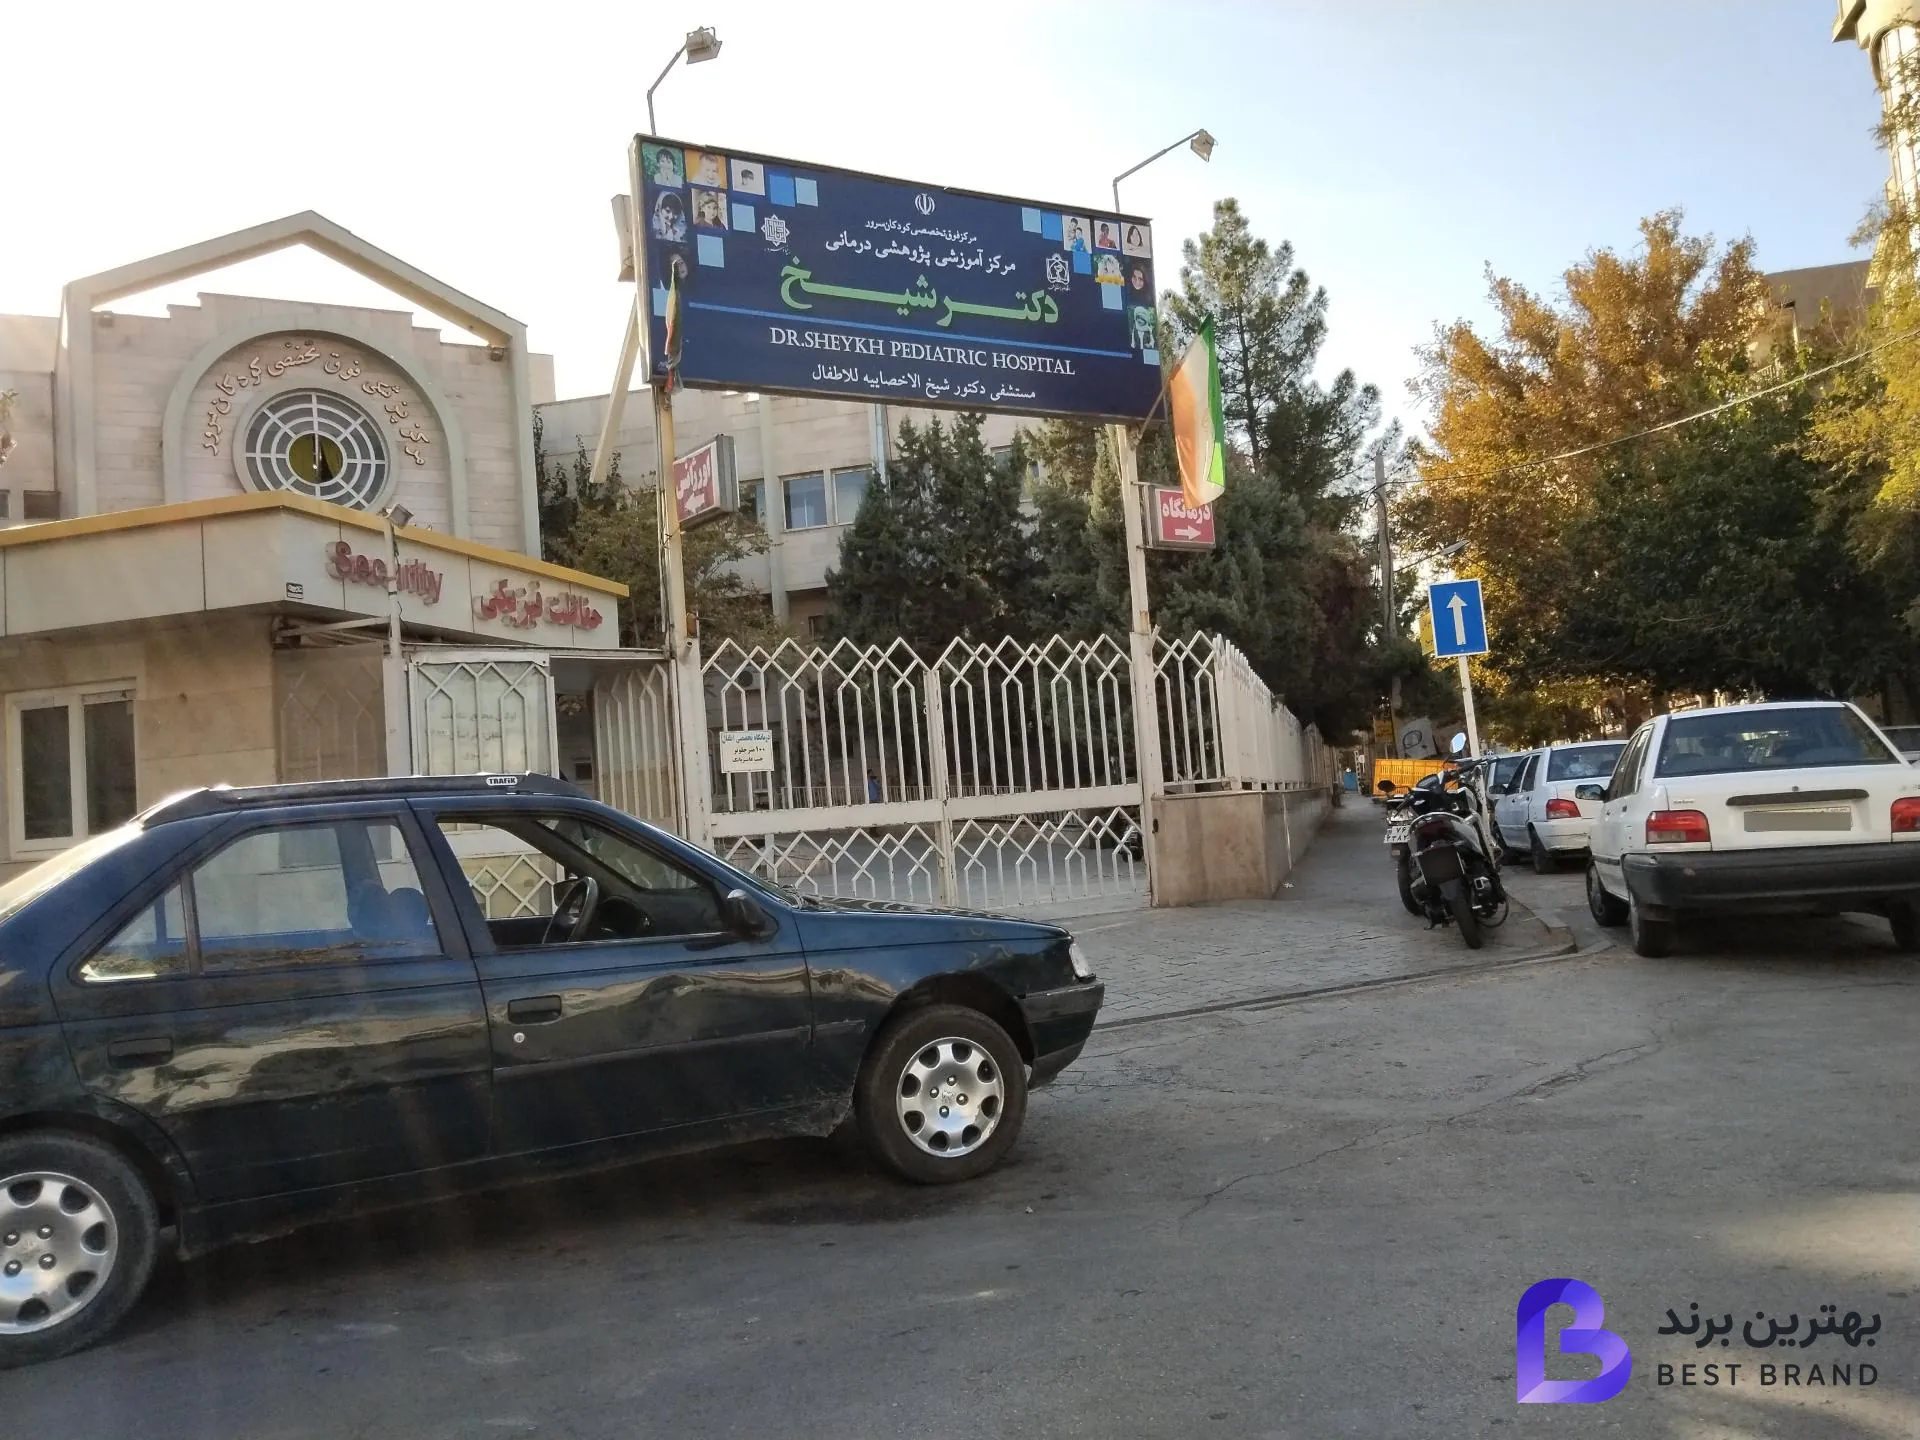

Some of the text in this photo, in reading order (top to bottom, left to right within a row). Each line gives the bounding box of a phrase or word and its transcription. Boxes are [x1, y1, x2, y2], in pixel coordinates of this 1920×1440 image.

[884, 219, 911, 234] کودکان
[959, 231, 977, 244] مرکز
[825, 231, 1016, 275] مرکز آموزشی پژوهشی درمانی
[780, 255, 1059, 327] دکتر شیخ
[769, 327, 1076, 375] DR.SHEYKH PEDIATRIC HOSPITAL
[324, 352, 361, 381] فوق
[812, 364, 859, 383] للاطفال
[925, 377, 950, 398] شیخ
[953, 380, 986, 398] دکتور
